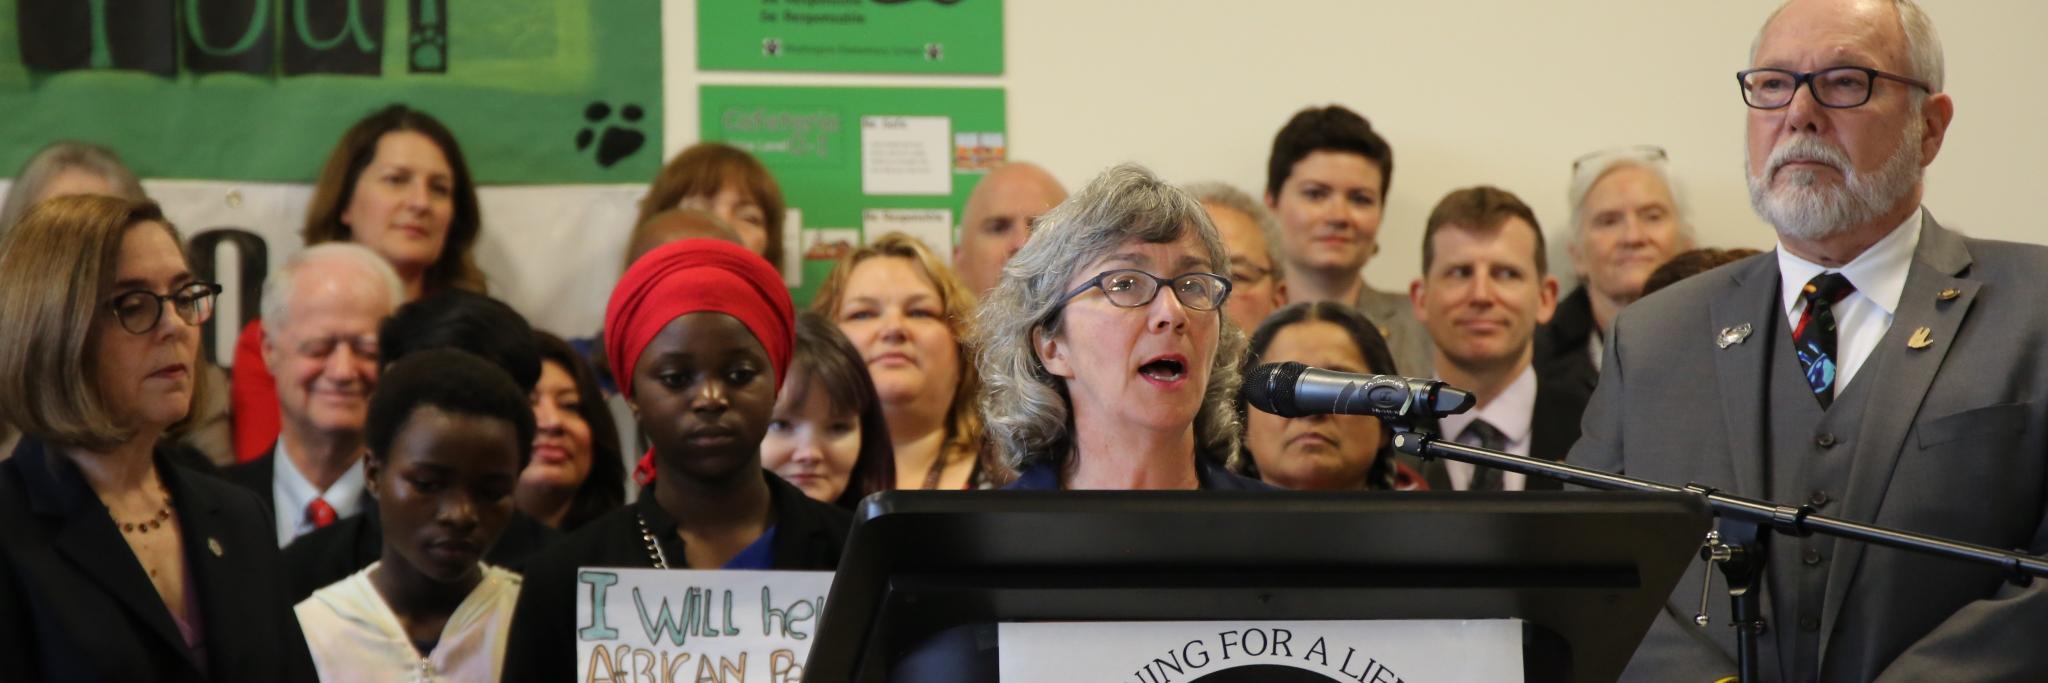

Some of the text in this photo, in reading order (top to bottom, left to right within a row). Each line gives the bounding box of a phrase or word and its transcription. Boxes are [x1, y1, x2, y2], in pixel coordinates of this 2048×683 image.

[578, 571, 618, 640] I
[761, 585, 825, 641] hel
[1218, 628, 1293, 660] FOR
[1303, 635, 1329, 667] A
[1338, 646, 1405, 683] LIF
